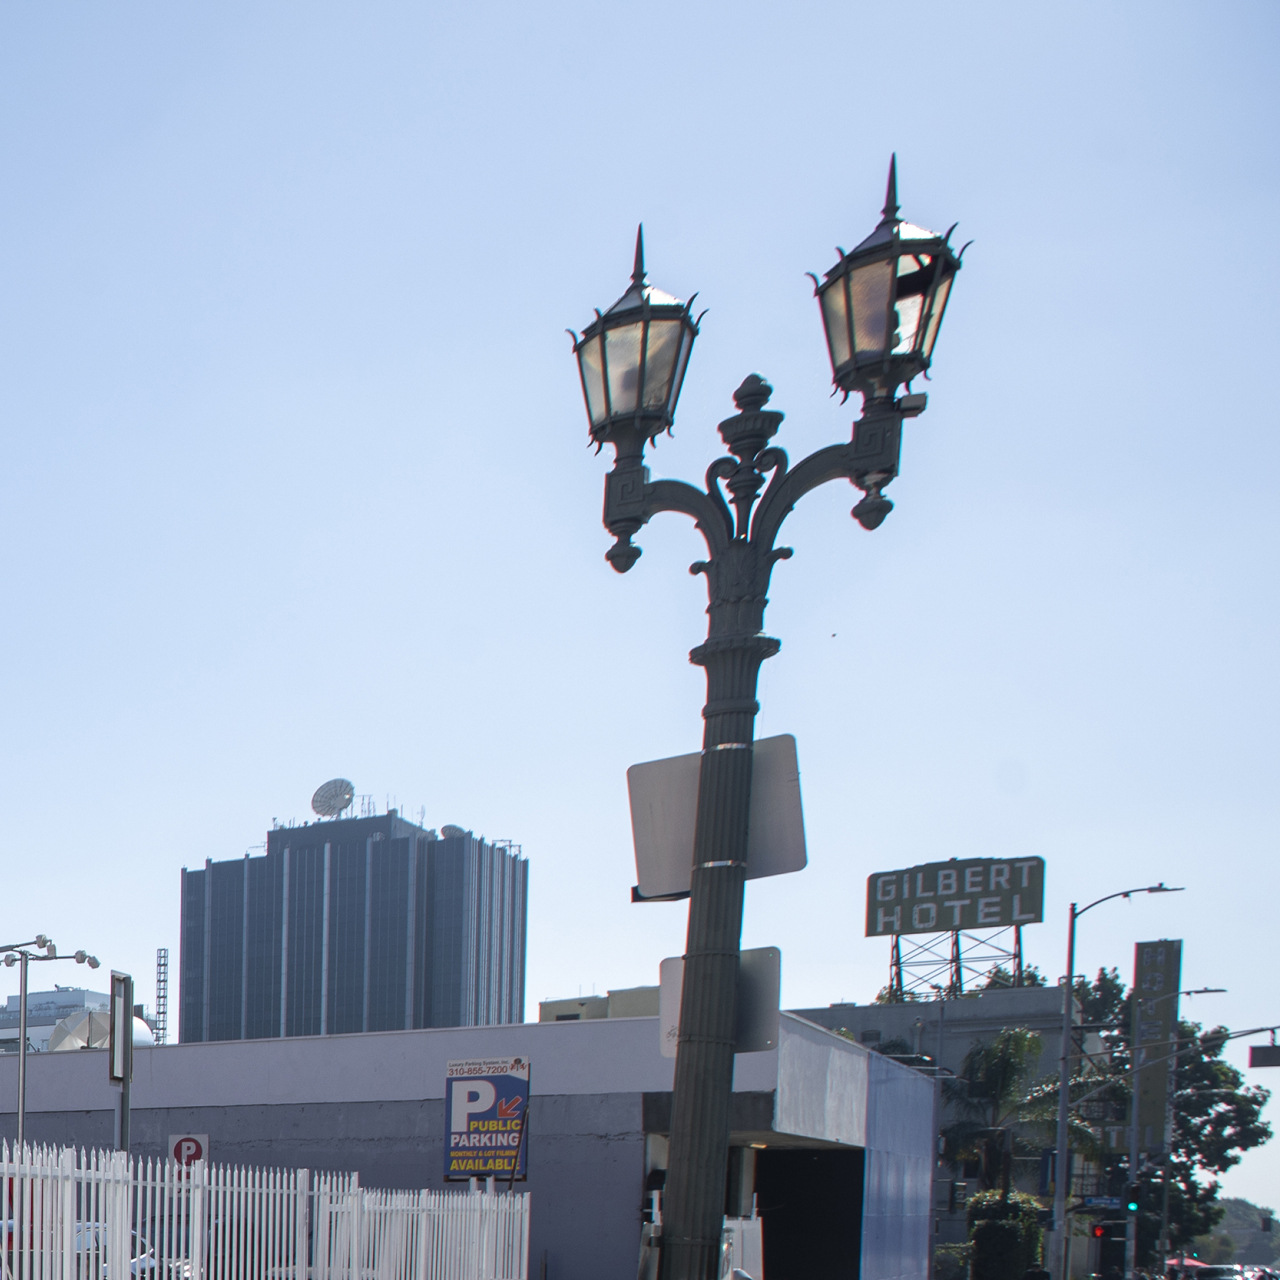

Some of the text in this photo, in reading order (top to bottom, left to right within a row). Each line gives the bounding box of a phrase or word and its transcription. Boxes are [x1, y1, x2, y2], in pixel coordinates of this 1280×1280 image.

[876, 861, 1037, 901] GILBERT
[876, 894, 1035, 932] HOTEL
[449, 1066, 507, 1076] 310-855-7200
[451, 1080, 496, 1132] P
[470, 1119, 522, 1132] PUBLIC
[451, 1133, 520, 1147] PARKING
[182, 1142, 196, 1163] P
